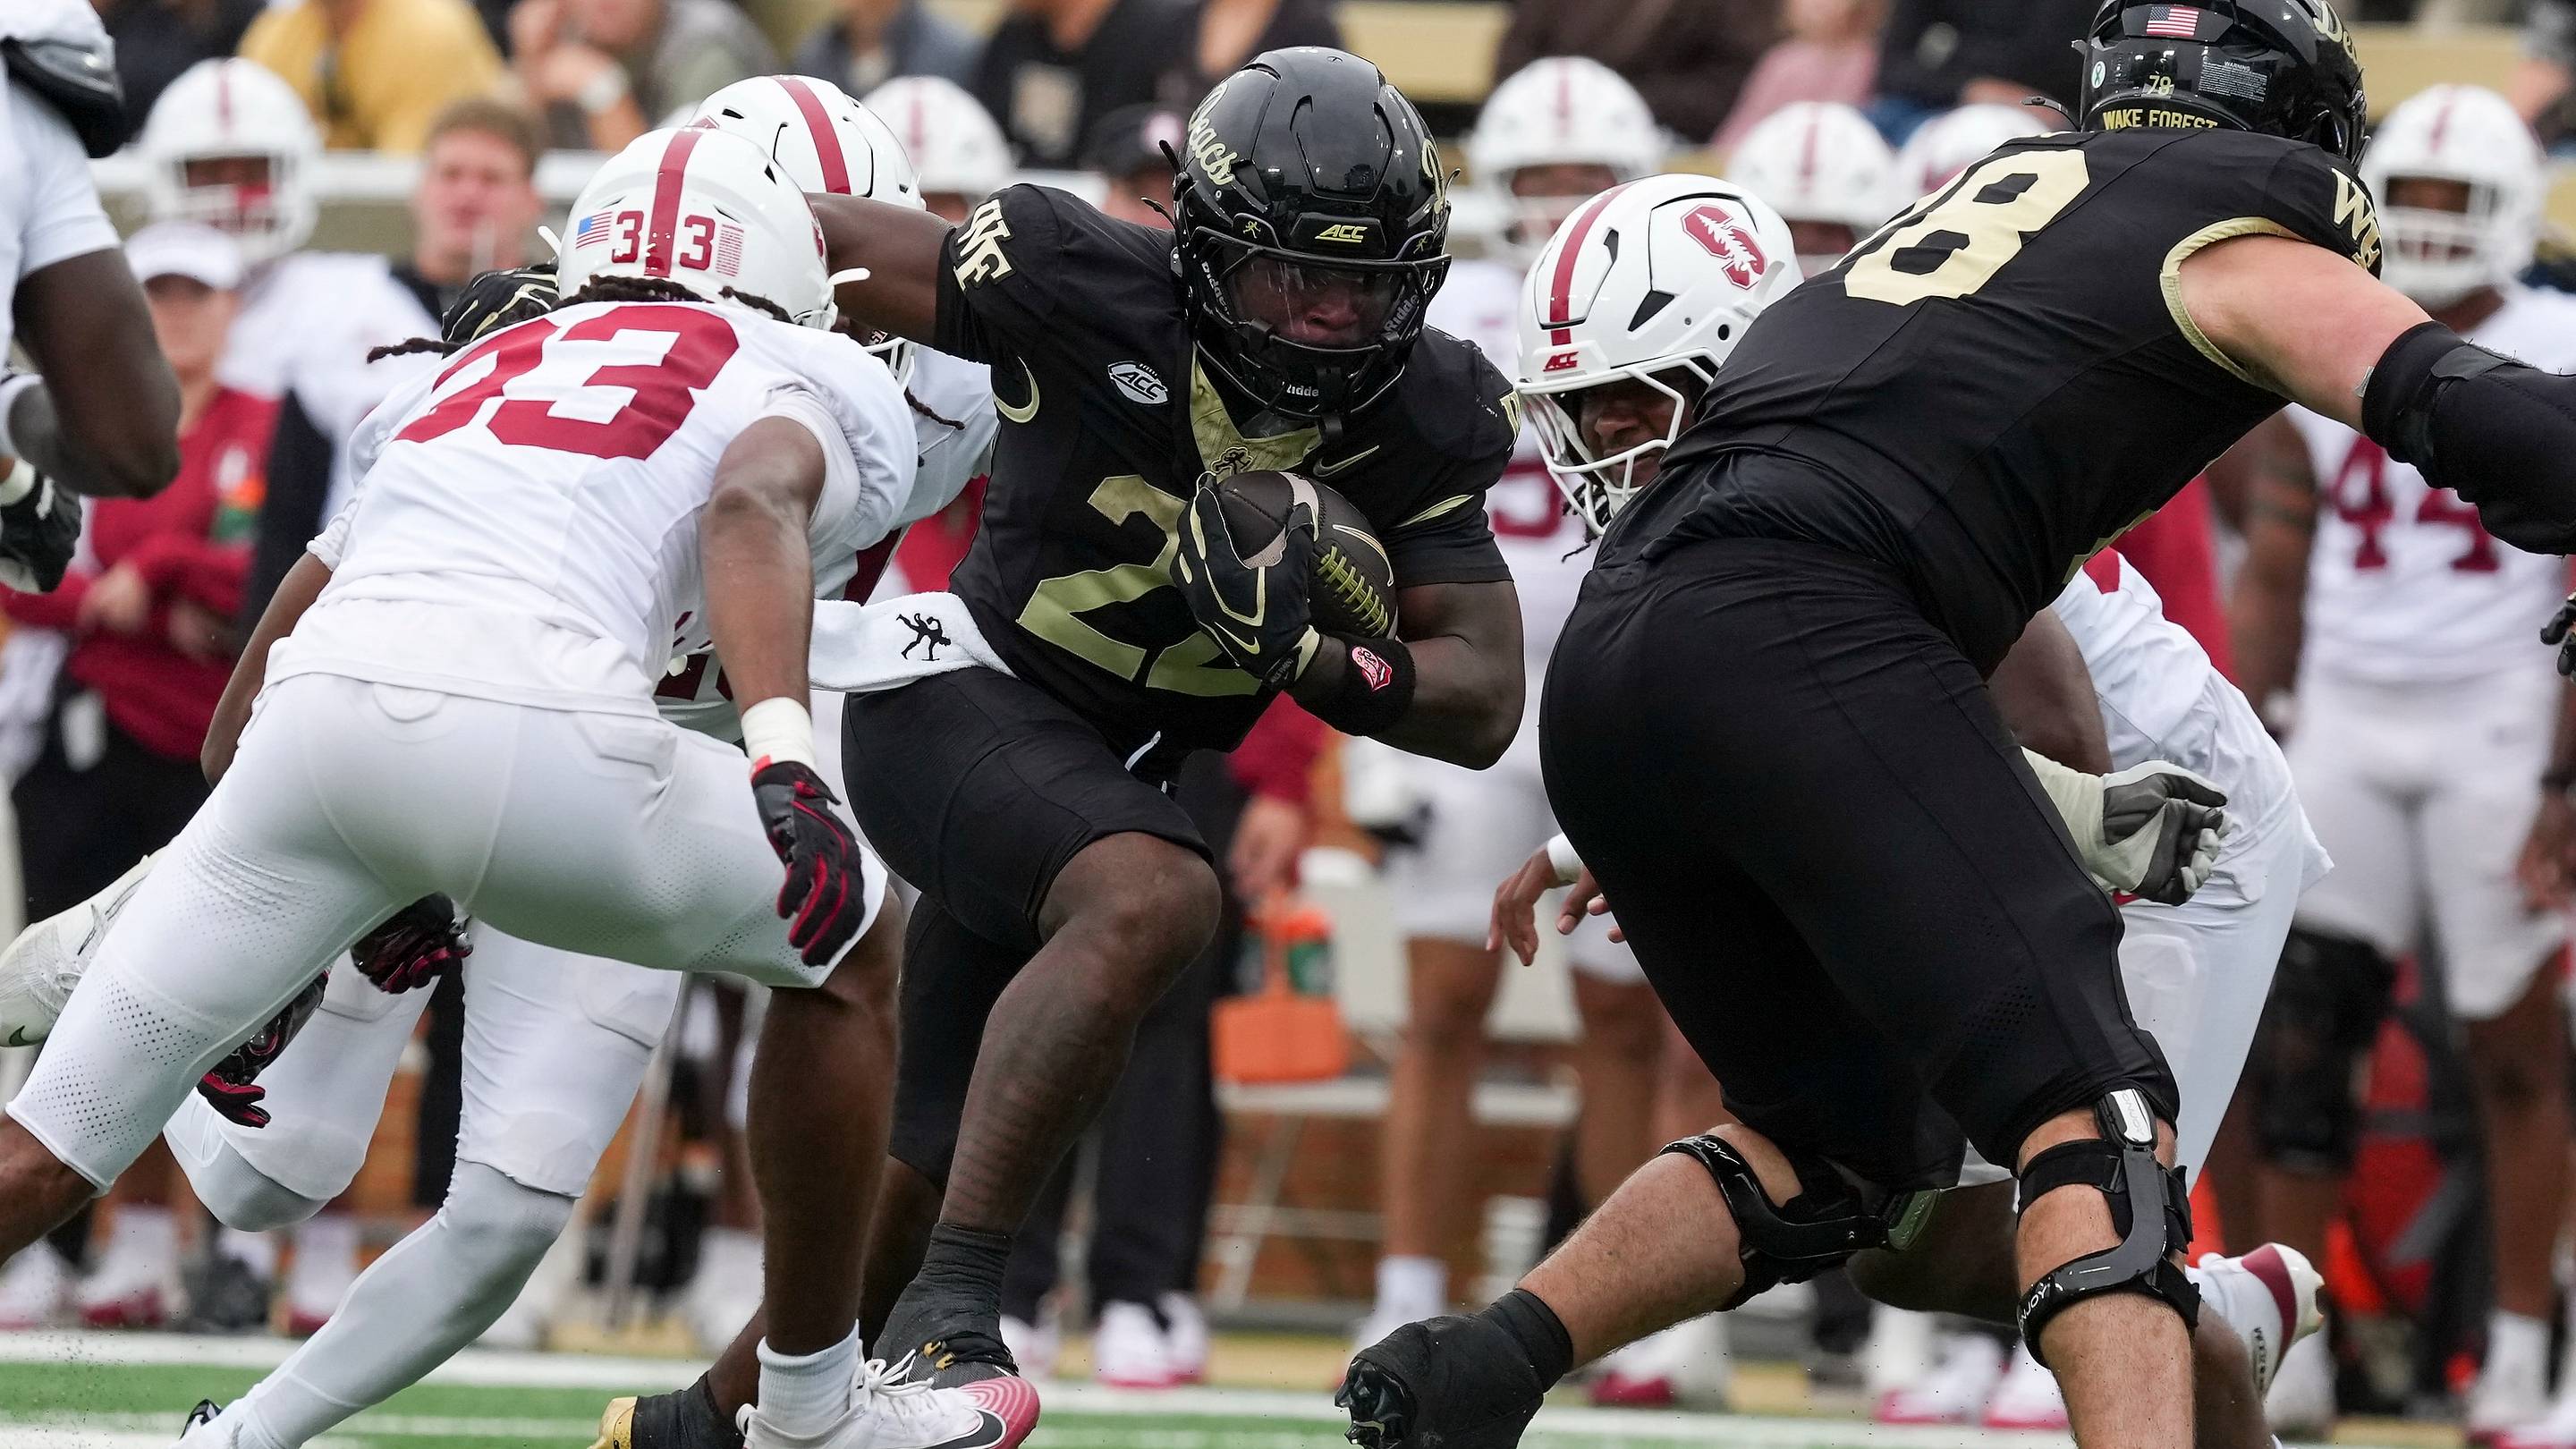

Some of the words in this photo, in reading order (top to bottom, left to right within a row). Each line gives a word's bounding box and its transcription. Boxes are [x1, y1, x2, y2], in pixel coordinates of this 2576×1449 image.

[2149, 75, 2172, 96] 78
[2103, 108, 2143, 131] WAKE
[953, 198, 1013, 292] WF
[1315, 224, 1368, 243] ACC
[1832, 145, 2090, 307] 8
[1384, 294, 1420, 334] Ridde
[1111, 370, 1166, 401] ACC
[2122, 1091, 2147, 1137] ONJOY
[2020, 1284, 2048, 1325] NJOY
